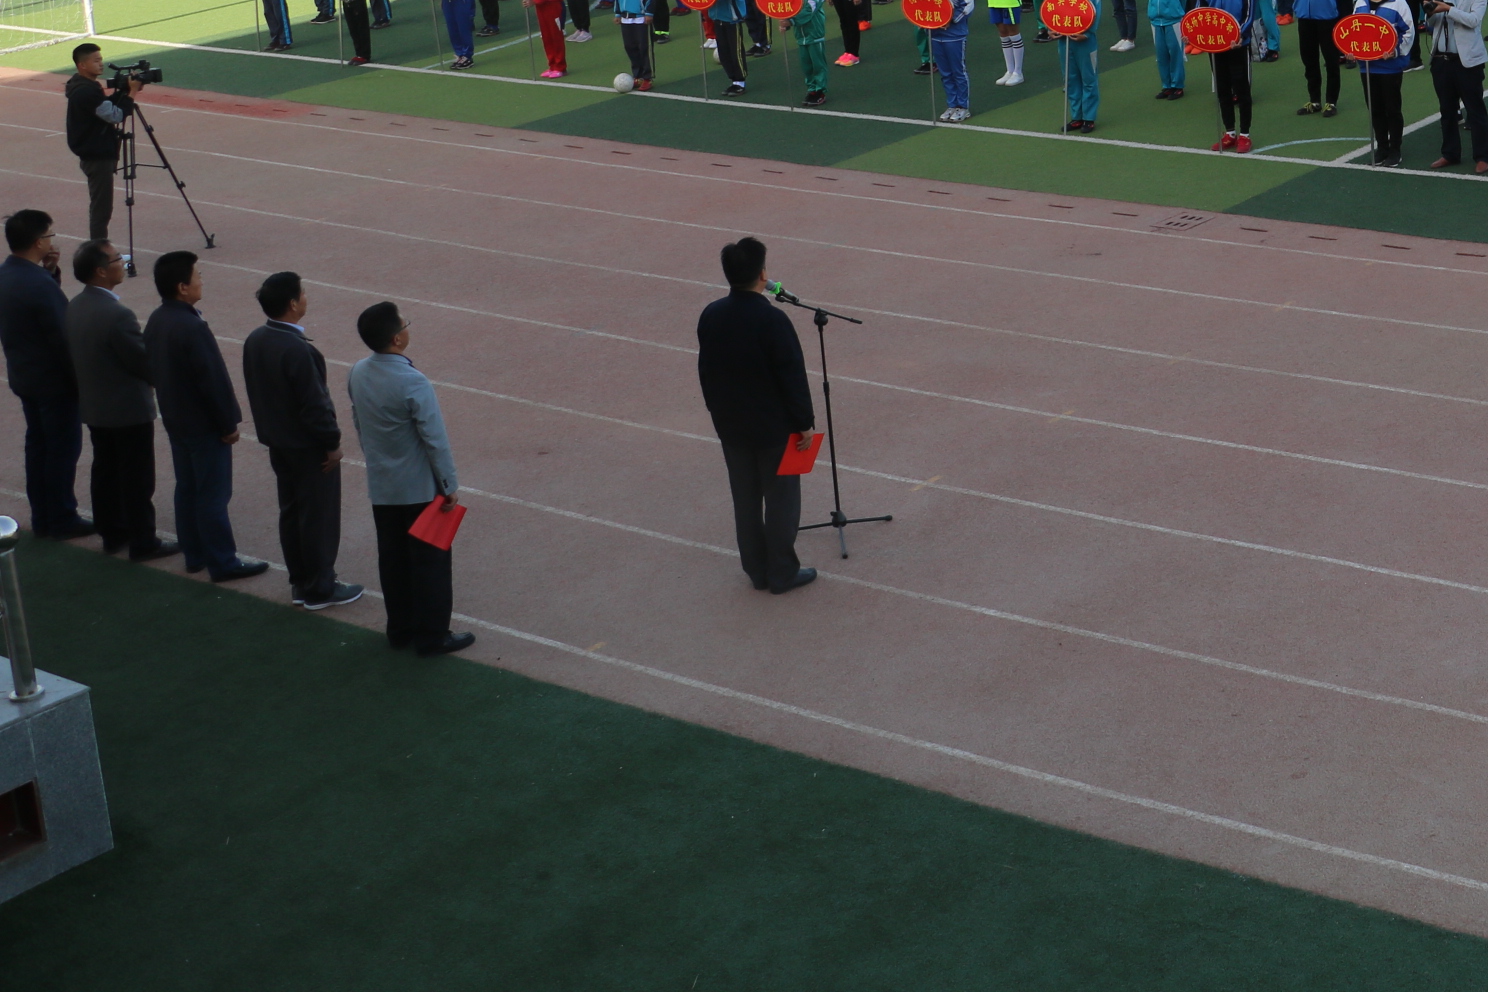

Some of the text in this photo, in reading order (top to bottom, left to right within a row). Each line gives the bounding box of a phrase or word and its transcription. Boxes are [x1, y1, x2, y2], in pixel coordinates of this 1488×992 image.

[768, 2, 793, 12] 代表队
[915, 10, 942, 22] 代表队
[1052, 15, 1083, 27] 代表队
[1340, 19, 1389, 39] 山丹一中
[1197, 35, 1225, 45] 代表队
[1351, 41, 1381, 52] 代表队
